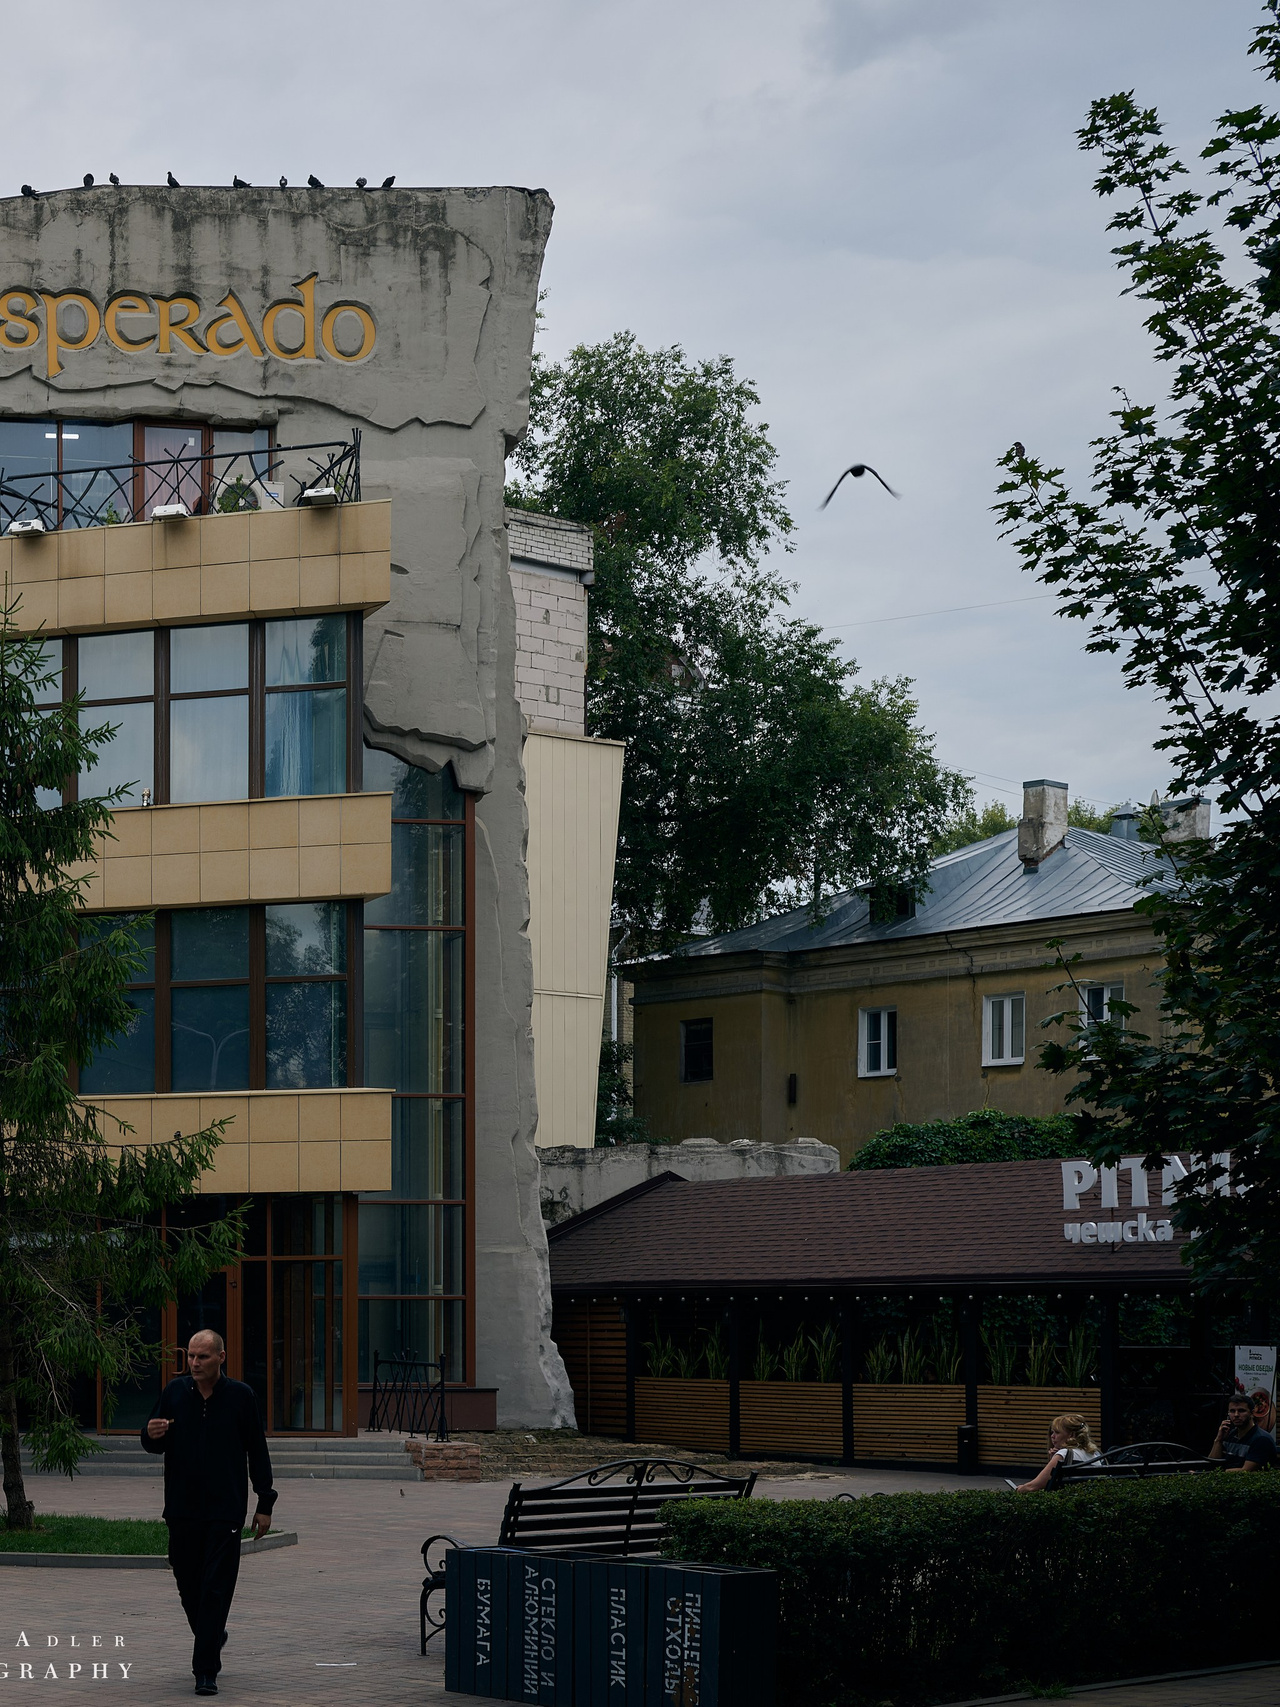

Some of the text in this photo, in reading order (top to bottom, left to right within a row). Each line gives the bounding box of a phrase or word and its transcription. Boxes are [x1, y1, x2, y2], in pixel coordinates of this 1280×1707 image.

[1238, 1363, 1274, 1373] НОВЫЕ ОБЕДЫ
[476, 1578, 491, 1666] БУМАГА
[540, 1577, 556, 1687] СТЕКЛО И
[610, 1587, 626, 1689] ПЛАСТИК
